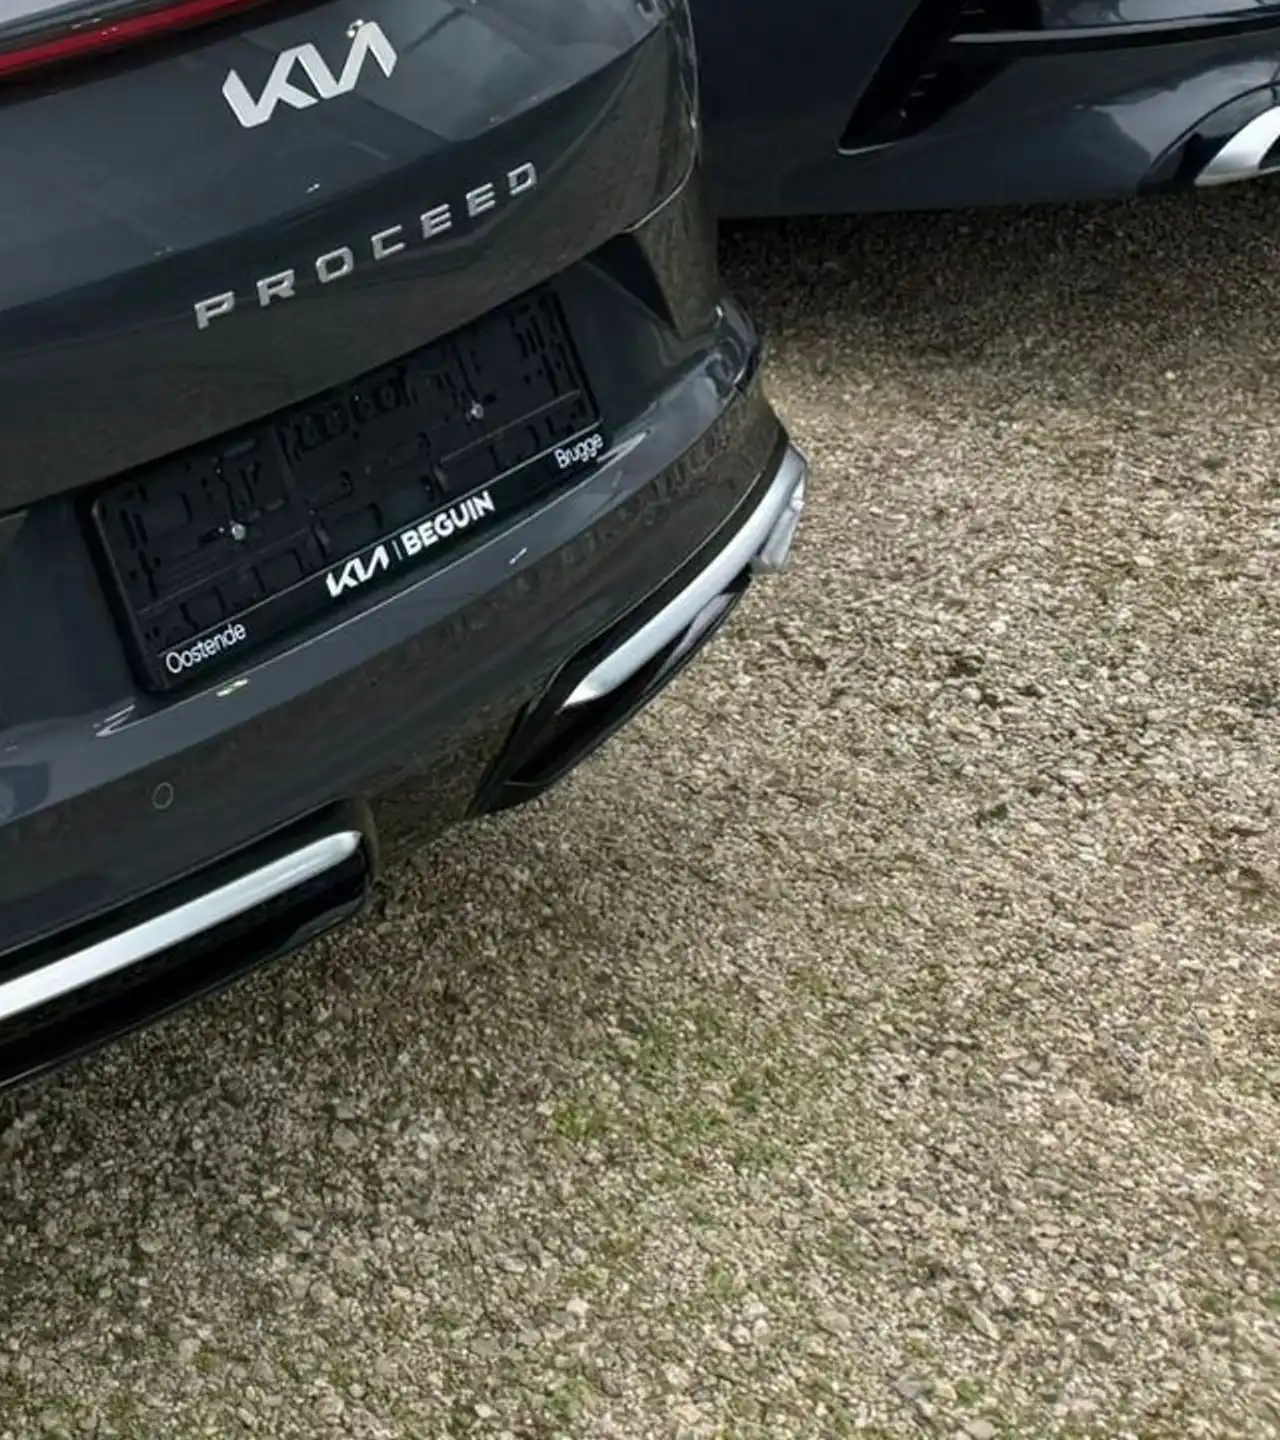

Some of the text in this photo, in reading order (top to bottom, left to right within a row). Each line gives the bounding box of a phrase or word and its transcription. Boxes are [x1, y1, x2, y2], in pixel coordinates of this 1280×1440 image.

[222, 21, 398, 129] KIA
[194, 161, 538, 330] PROCEED
[165, 431, 604, 674] Oostende KIA BEGUIN Brugge
